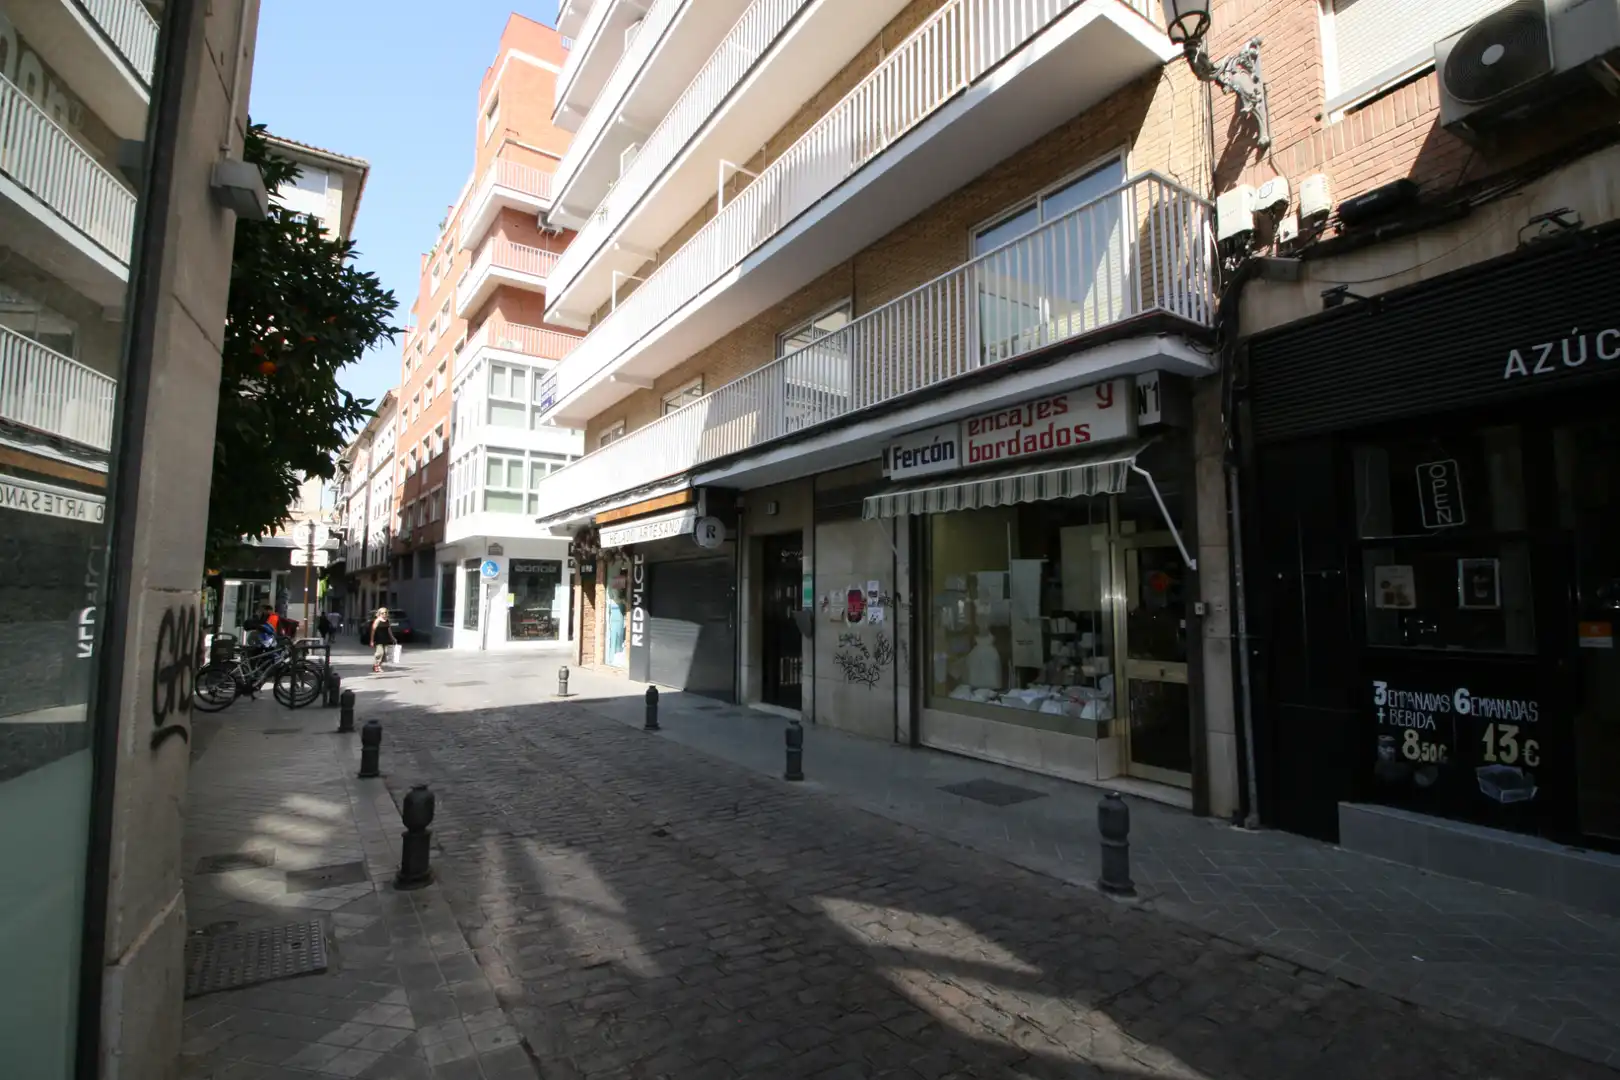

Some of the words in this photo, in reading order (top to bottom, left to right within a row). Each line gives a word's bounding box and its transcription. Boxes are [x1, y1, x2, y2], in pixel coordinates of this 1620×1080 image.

[1503, 326, 1620, 380] AZÚC
[967, 395, 1068, 436] encajes
[1095, 381, 1113, 411] y
[893, 436, 954, 470] Fercón
[968, 422, 1090, 463] bordados
[1428, 464, 1453, 524] OPEN
[639, 518, 681, 539] ARTESANO
[706, 525, 716, 539] R
[1372, 680, 1388, 706] 3
[1387, 689, 1451, 713] EMPANADAS
[1454, 687, 1470, 715] 6
[1470, 696, 1540, 723] EMPANADAS
[1389, 708, 1436, 731] BEBIDA
